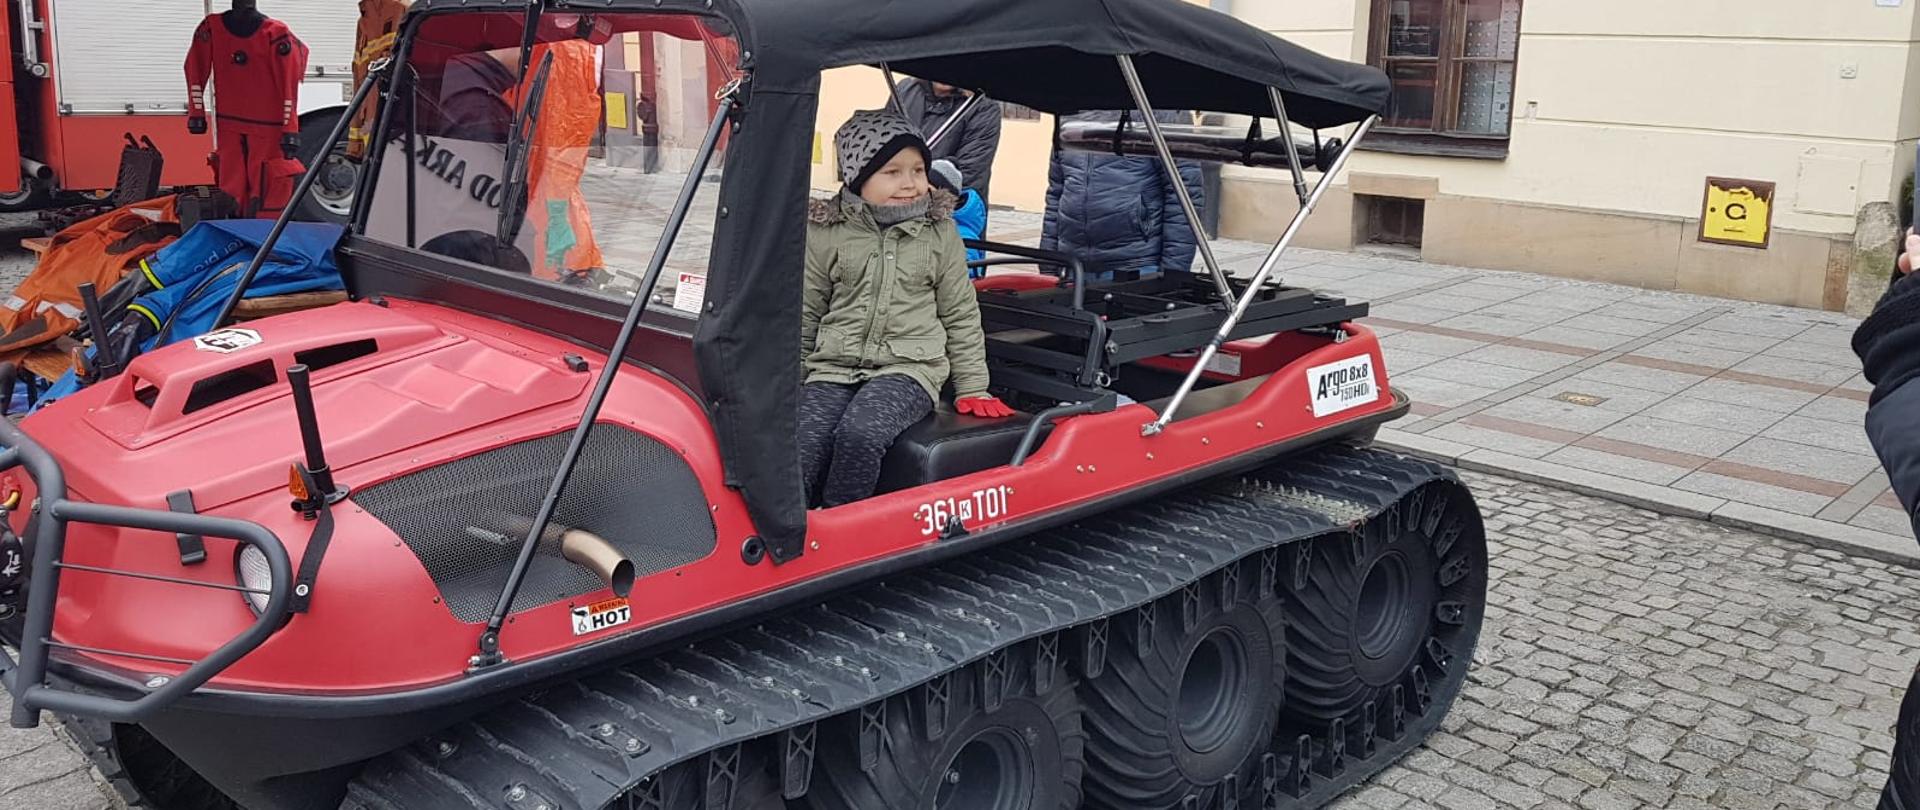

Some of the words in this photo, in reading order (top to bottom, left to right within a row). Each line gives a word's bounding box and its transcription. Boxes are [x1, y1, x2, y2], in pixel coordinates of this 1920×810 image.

[1317, 368, 1347, 401] Argo
[1349, 363, 1368, 382] 8x8
[592, 608, 628, 628] HOT
